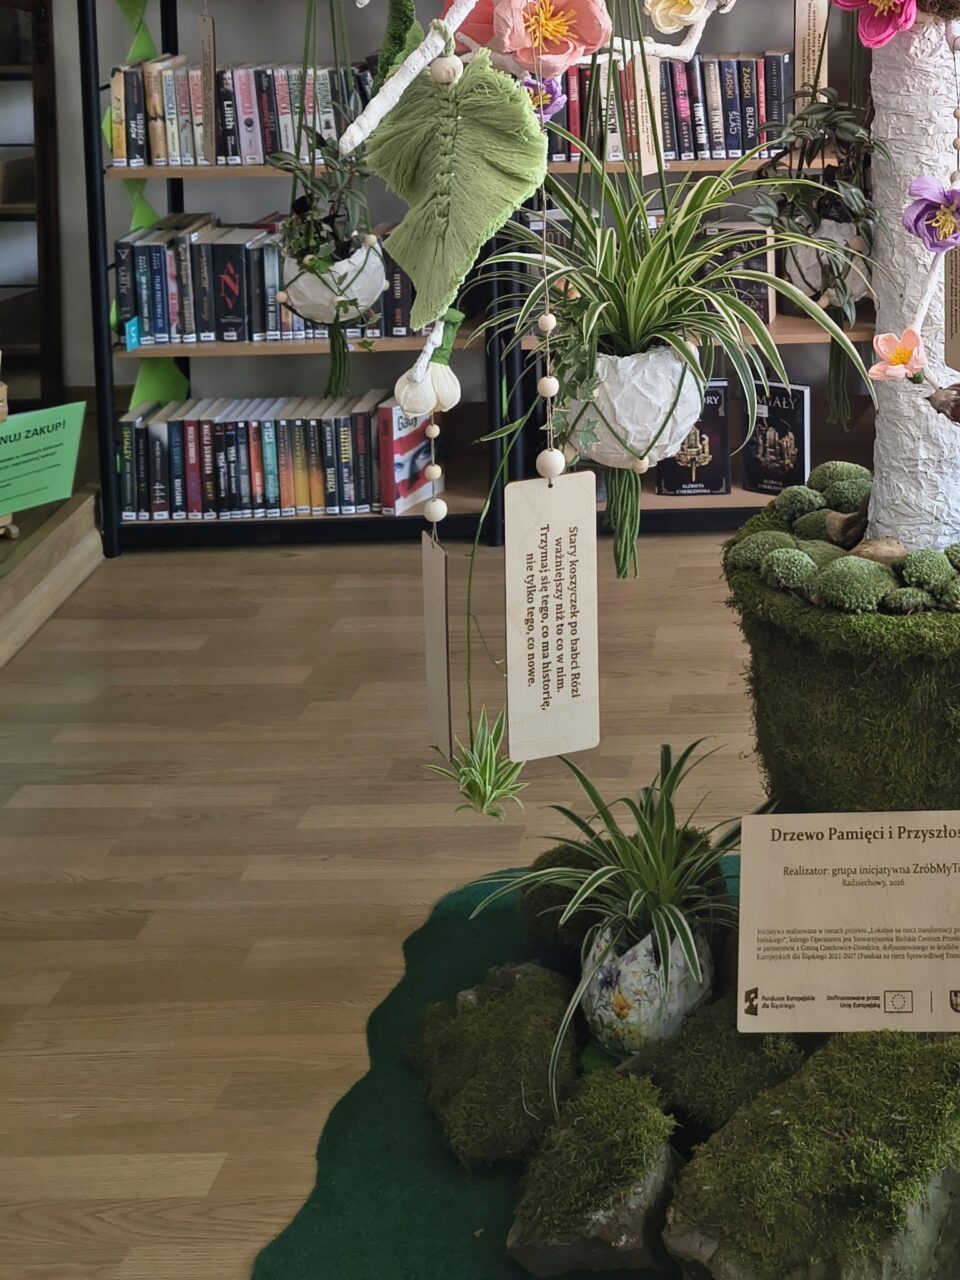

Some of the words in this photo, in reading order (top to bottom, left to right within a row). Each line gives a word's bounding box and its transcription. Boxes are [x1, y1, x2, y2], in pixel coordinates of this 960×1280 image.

[223, 100, 235, 129] Lilith
[745, 106, 755, 138] BLIZNA
[24, 420, 66, 440] ZAKUP!
[538, 524, 550, 573] Trzymaj
[567, 526, 579, 557] Stary
[526, 553, 536, 571] nie
[553, 537, 565, 601] ważniejszy
[524, 574, 536, 604] tylko
[539, 575, 550, 592] się
[567, 559, 580, 619] koszyczek
[539, 594, 549, 623] tego,
[555, 603, 566, 622] niż
[524, 606, 535, 635] tego,
[542, 625, 549, 638] co
[556, 623, 564, 635] to
[568, 621, 578, 636] po
[527, 637, 534, 650] co
[541, 641, 549, 659] ma
[556, 638, 563, 651] co
[570, 638, 580, 670] babci
[556, 653, 563, 664] w
[527, 653, 535, 688] nowe.
[557, 666, 566, 693] nim.
[541, 661, 552, 711] historię,
[571, 672, 581, 699] Rózi
[770, 828, 825, 842] Drzewo
[828, 826, 885, 843] Pamięci
[888, 826, 893, 840] i
[783, 865, 830, 876] Realizator:
[832, 867, 857, 878] grupa
[859, 864, 910, 877] inicjatywna
[842, 878, 888, 888] Radziechowy,
